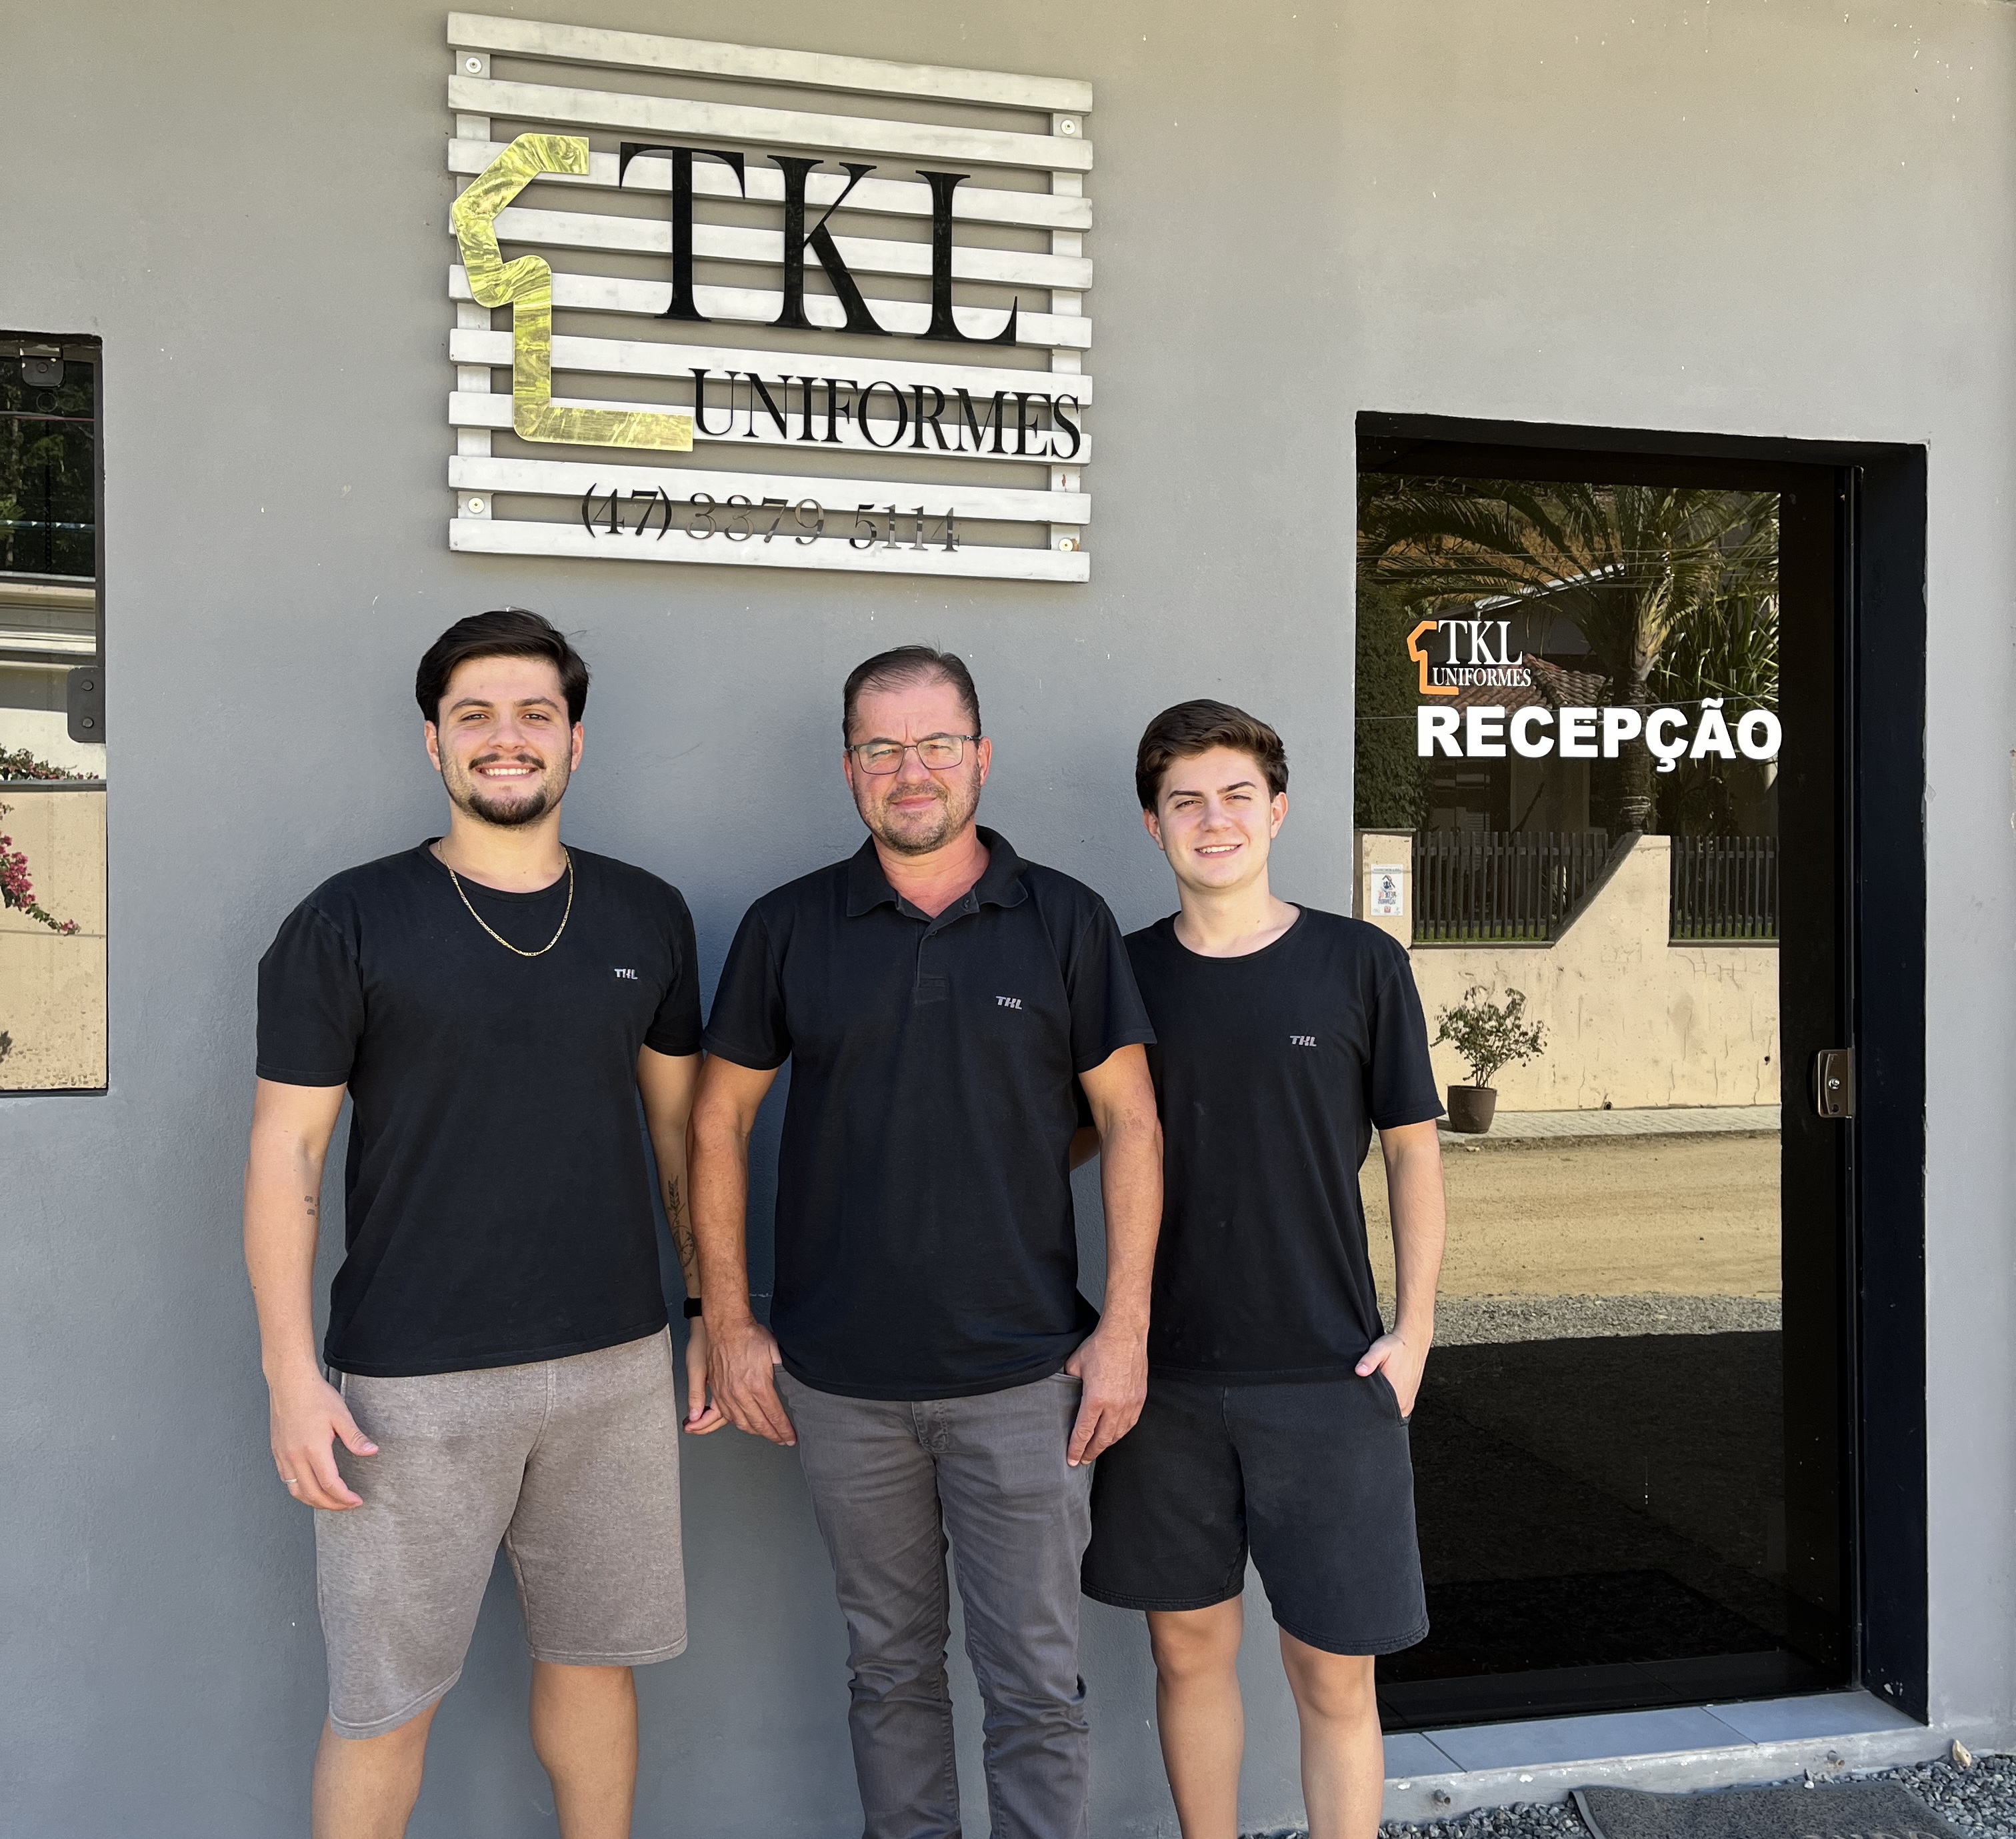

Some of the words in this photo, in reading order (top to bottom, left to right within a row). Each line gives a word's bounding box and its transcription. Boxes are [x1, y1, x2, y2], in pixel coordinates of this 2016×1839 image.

[620, 142, 1017, 345] TKL
[688, 368, 1081, 458] UNIFORMES
[581, 482, 672, 541] (47)
[685, 492, 825, 545] 3379
[849, 503, 961, 553] 5114
[1433, 667, 1531, 687] UNIFORMES
[1438, 620, 1523, 665] TKL
[1417, 697, 1782, 772] RECEPÇÃO
